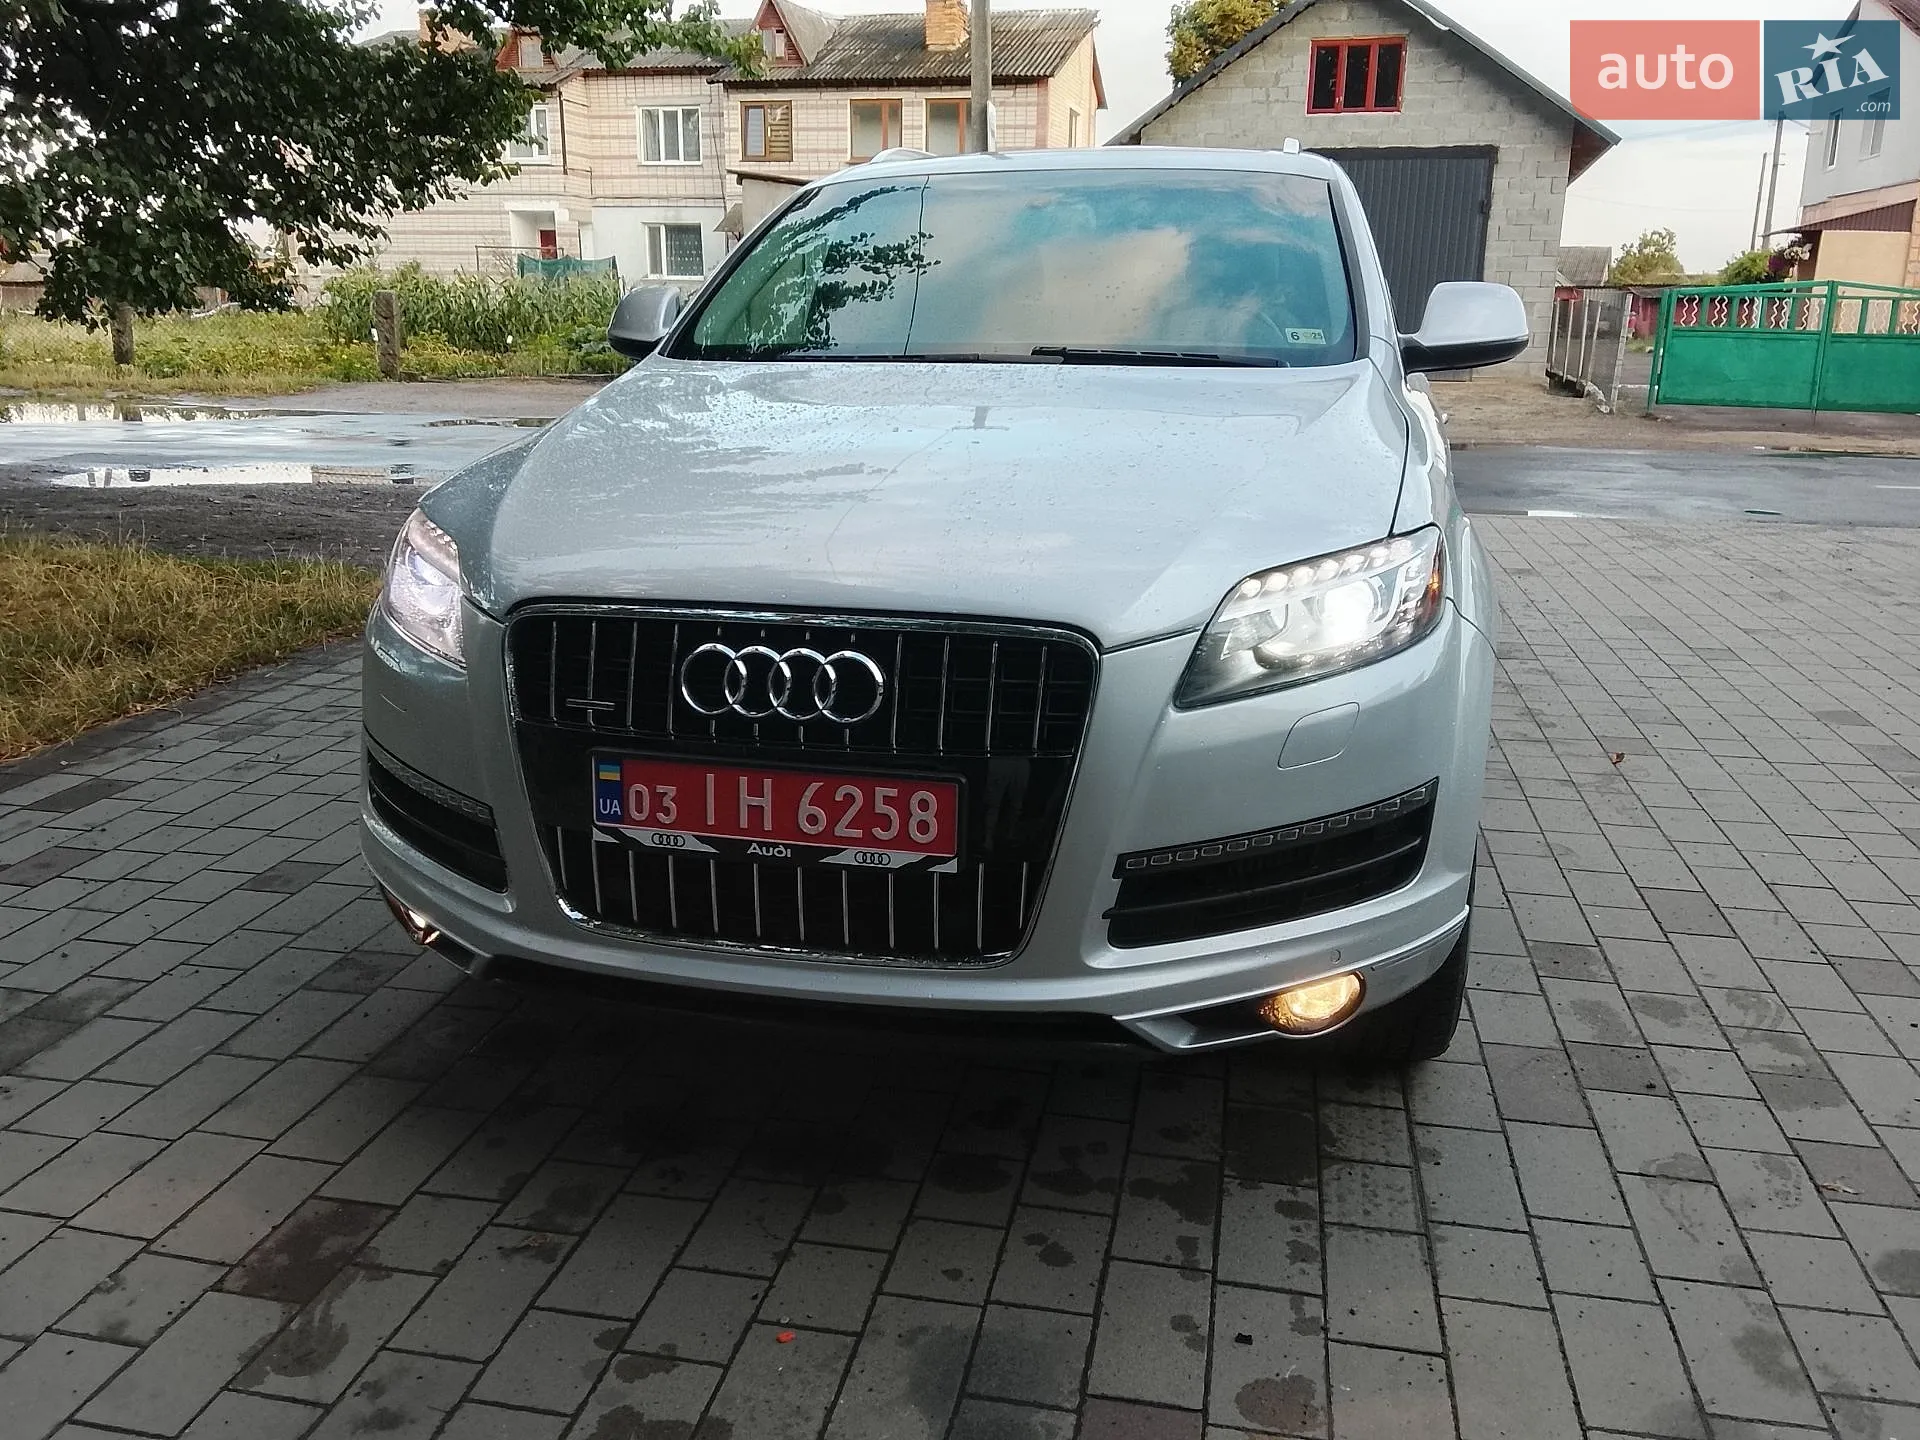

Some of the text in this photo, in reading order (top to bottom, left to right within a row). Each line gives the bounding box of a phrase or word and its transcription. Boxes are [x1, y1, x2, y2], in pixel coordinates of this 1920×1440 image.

[1290, 331, 1300, 341] 6
[599, 798, 622, 816] UA
[628, 783, 677, 825] 03
[797, 781, 938, 844] 6258
[746, 842, 792, 858] Audi
